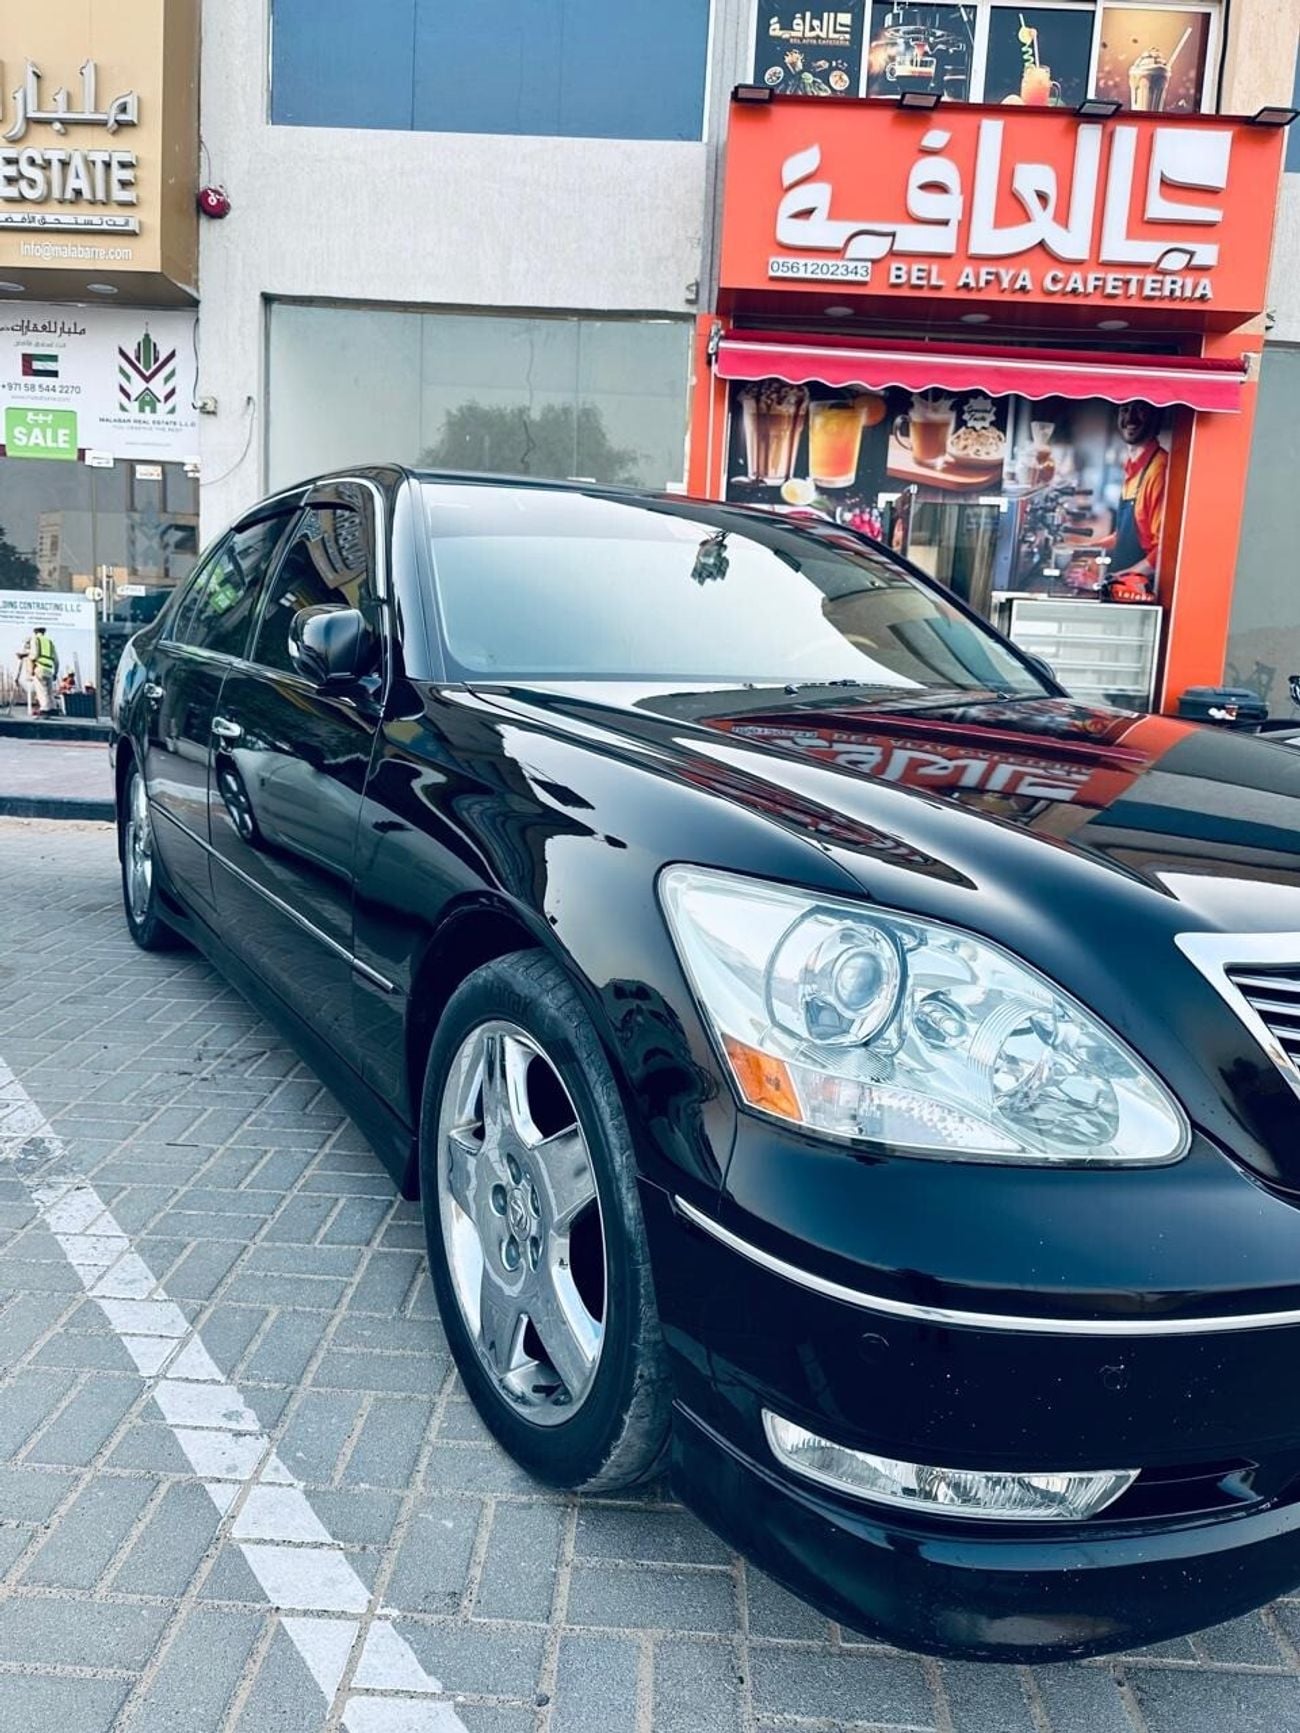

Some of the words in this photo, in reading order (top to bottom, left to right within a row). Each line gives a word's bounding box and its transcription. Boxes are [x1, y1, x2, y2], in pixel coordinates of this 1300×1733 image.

[0, 148, 137, 205] ESTATE
[770, 259, 870, 278] 0561202343
[889, 263, 945, 288] BEL
[956, 265, 1033, 292] AFYA
[1042, 269, 1214, 301] CAFETERIA
[24, 383, 36, 393] 58
[38, 384, 56, 393] 544
[59, 384, 81, 394] 2270
[13, 426, 70, 448] SALE
